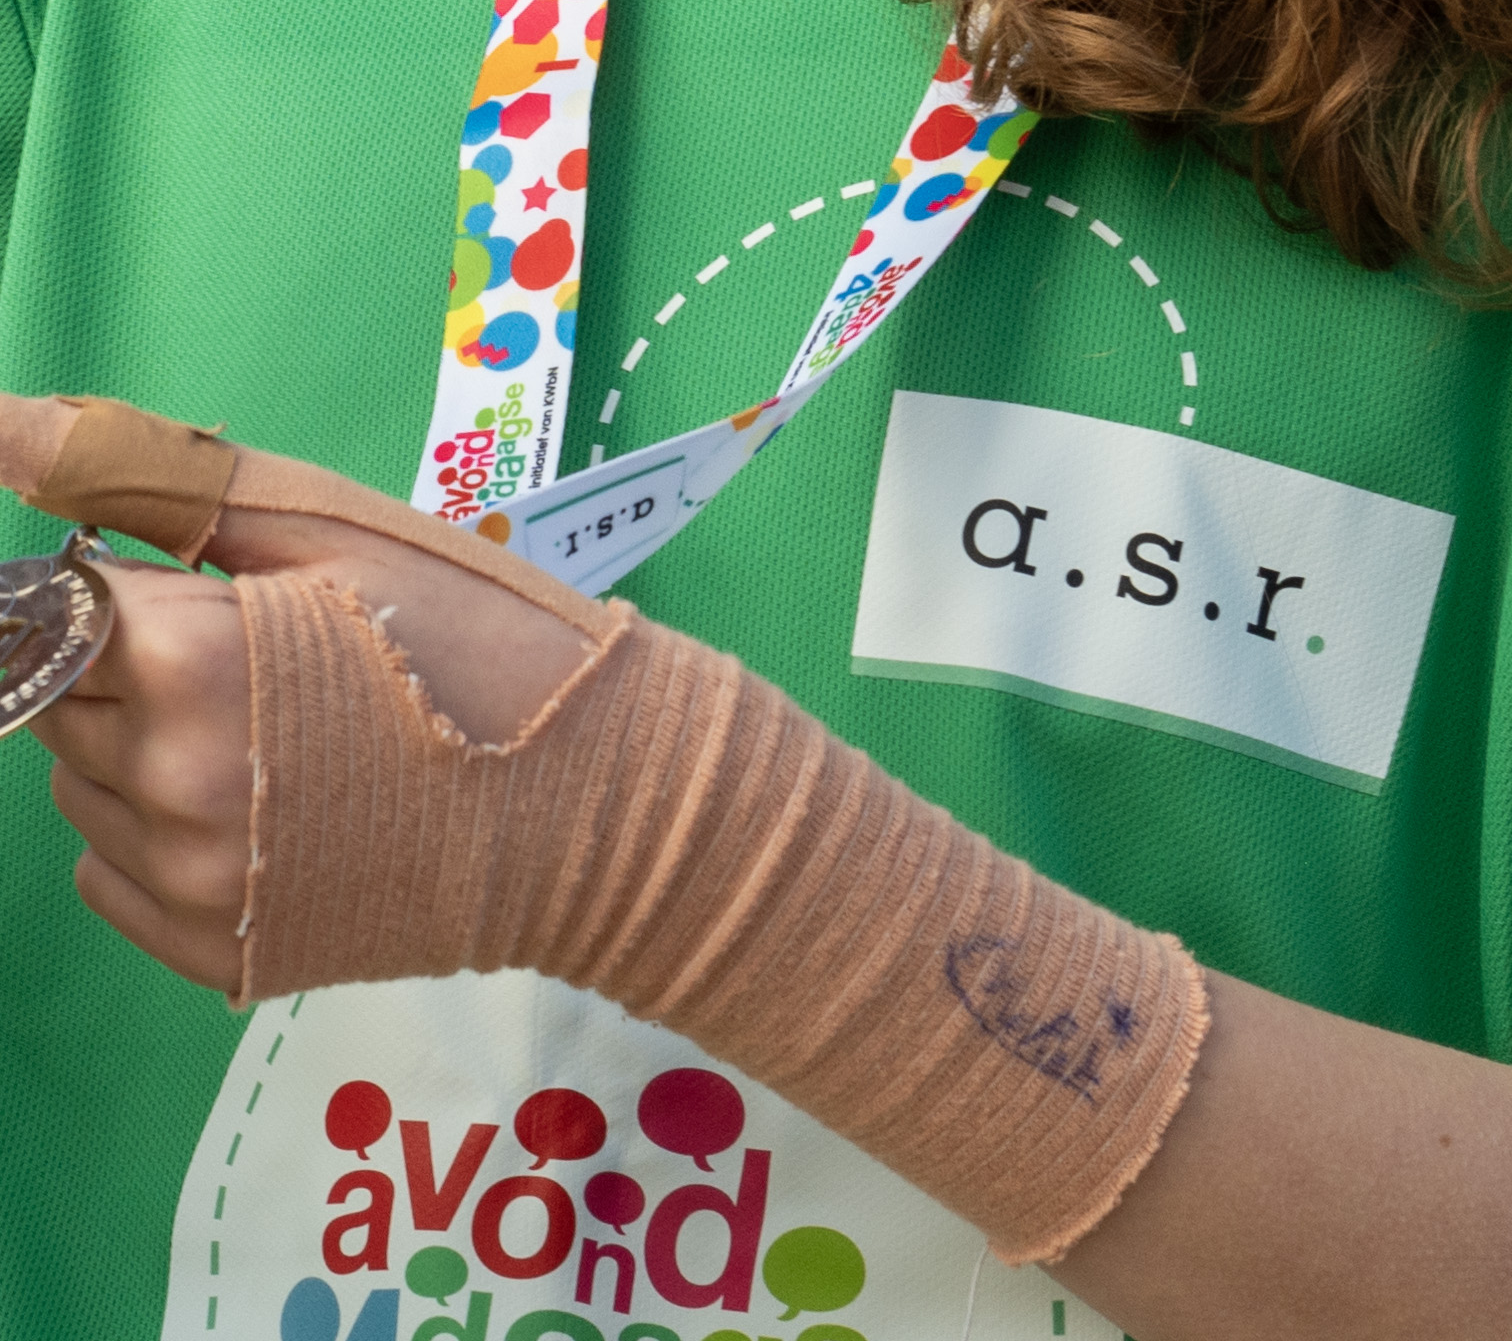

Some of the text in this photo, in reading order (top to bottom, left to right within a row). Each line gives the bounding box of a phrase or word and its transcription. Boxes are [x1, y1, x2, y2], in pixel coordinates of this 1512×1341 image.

[484, 382, 534, 509] daagse
[541, 409, 554, 435] van
[961, 498, 1326, 656] a.s.r.
[321, 1118, 773, 1315] avond
